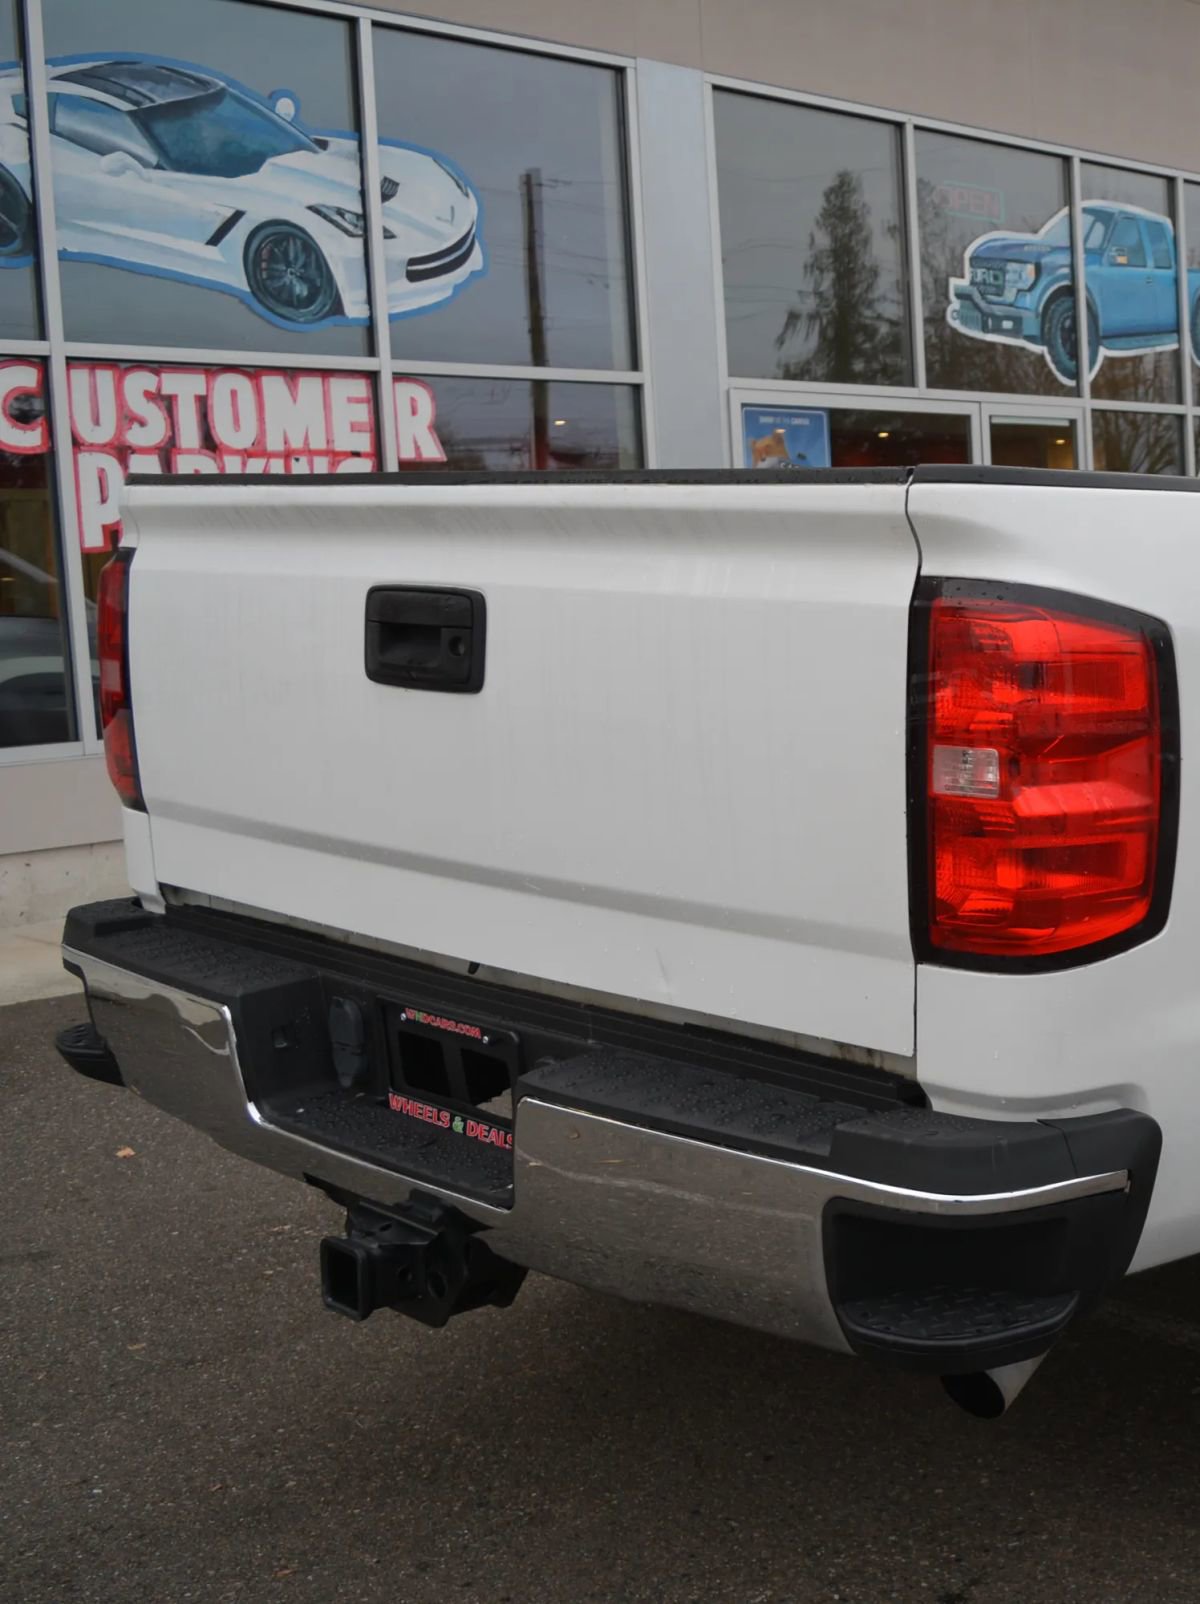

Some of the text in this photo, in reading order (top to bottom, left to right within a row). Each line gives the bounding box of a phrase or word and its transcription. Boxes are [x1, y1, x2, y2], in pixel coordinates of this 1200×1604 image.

[0, 359, 447, 463] CUSTOMER
[388, 1093, 513, 1150] WHEELS & DEALS
